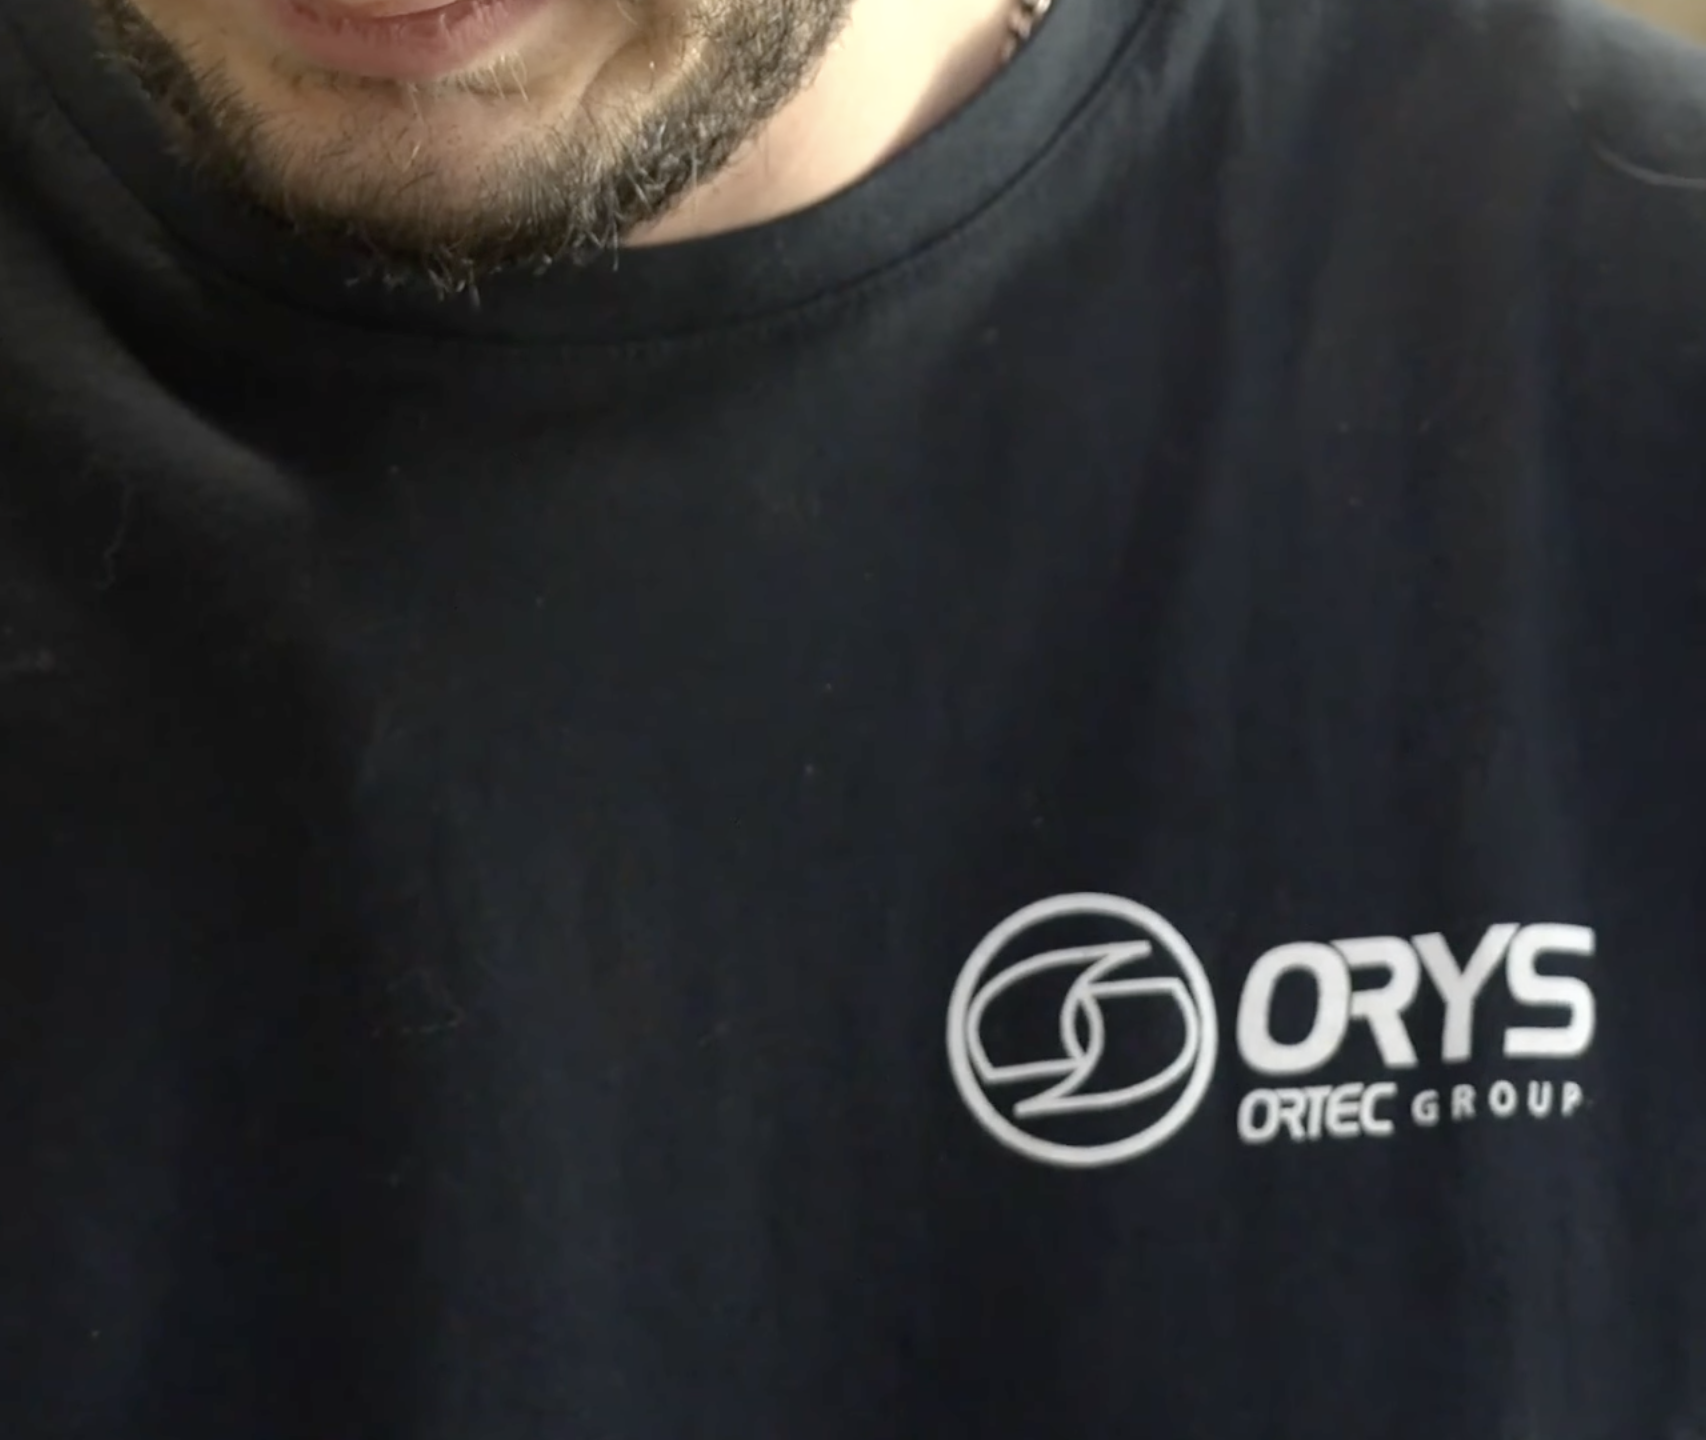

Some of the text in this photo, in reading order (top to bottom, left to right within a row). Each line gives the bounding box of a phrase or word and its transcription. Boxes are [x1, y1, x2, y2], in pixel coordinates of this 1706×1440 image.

[1237, 922, 1596, 1075] ORYS
[1237, 1079, 1583, 1143] ORTEC GROUP
